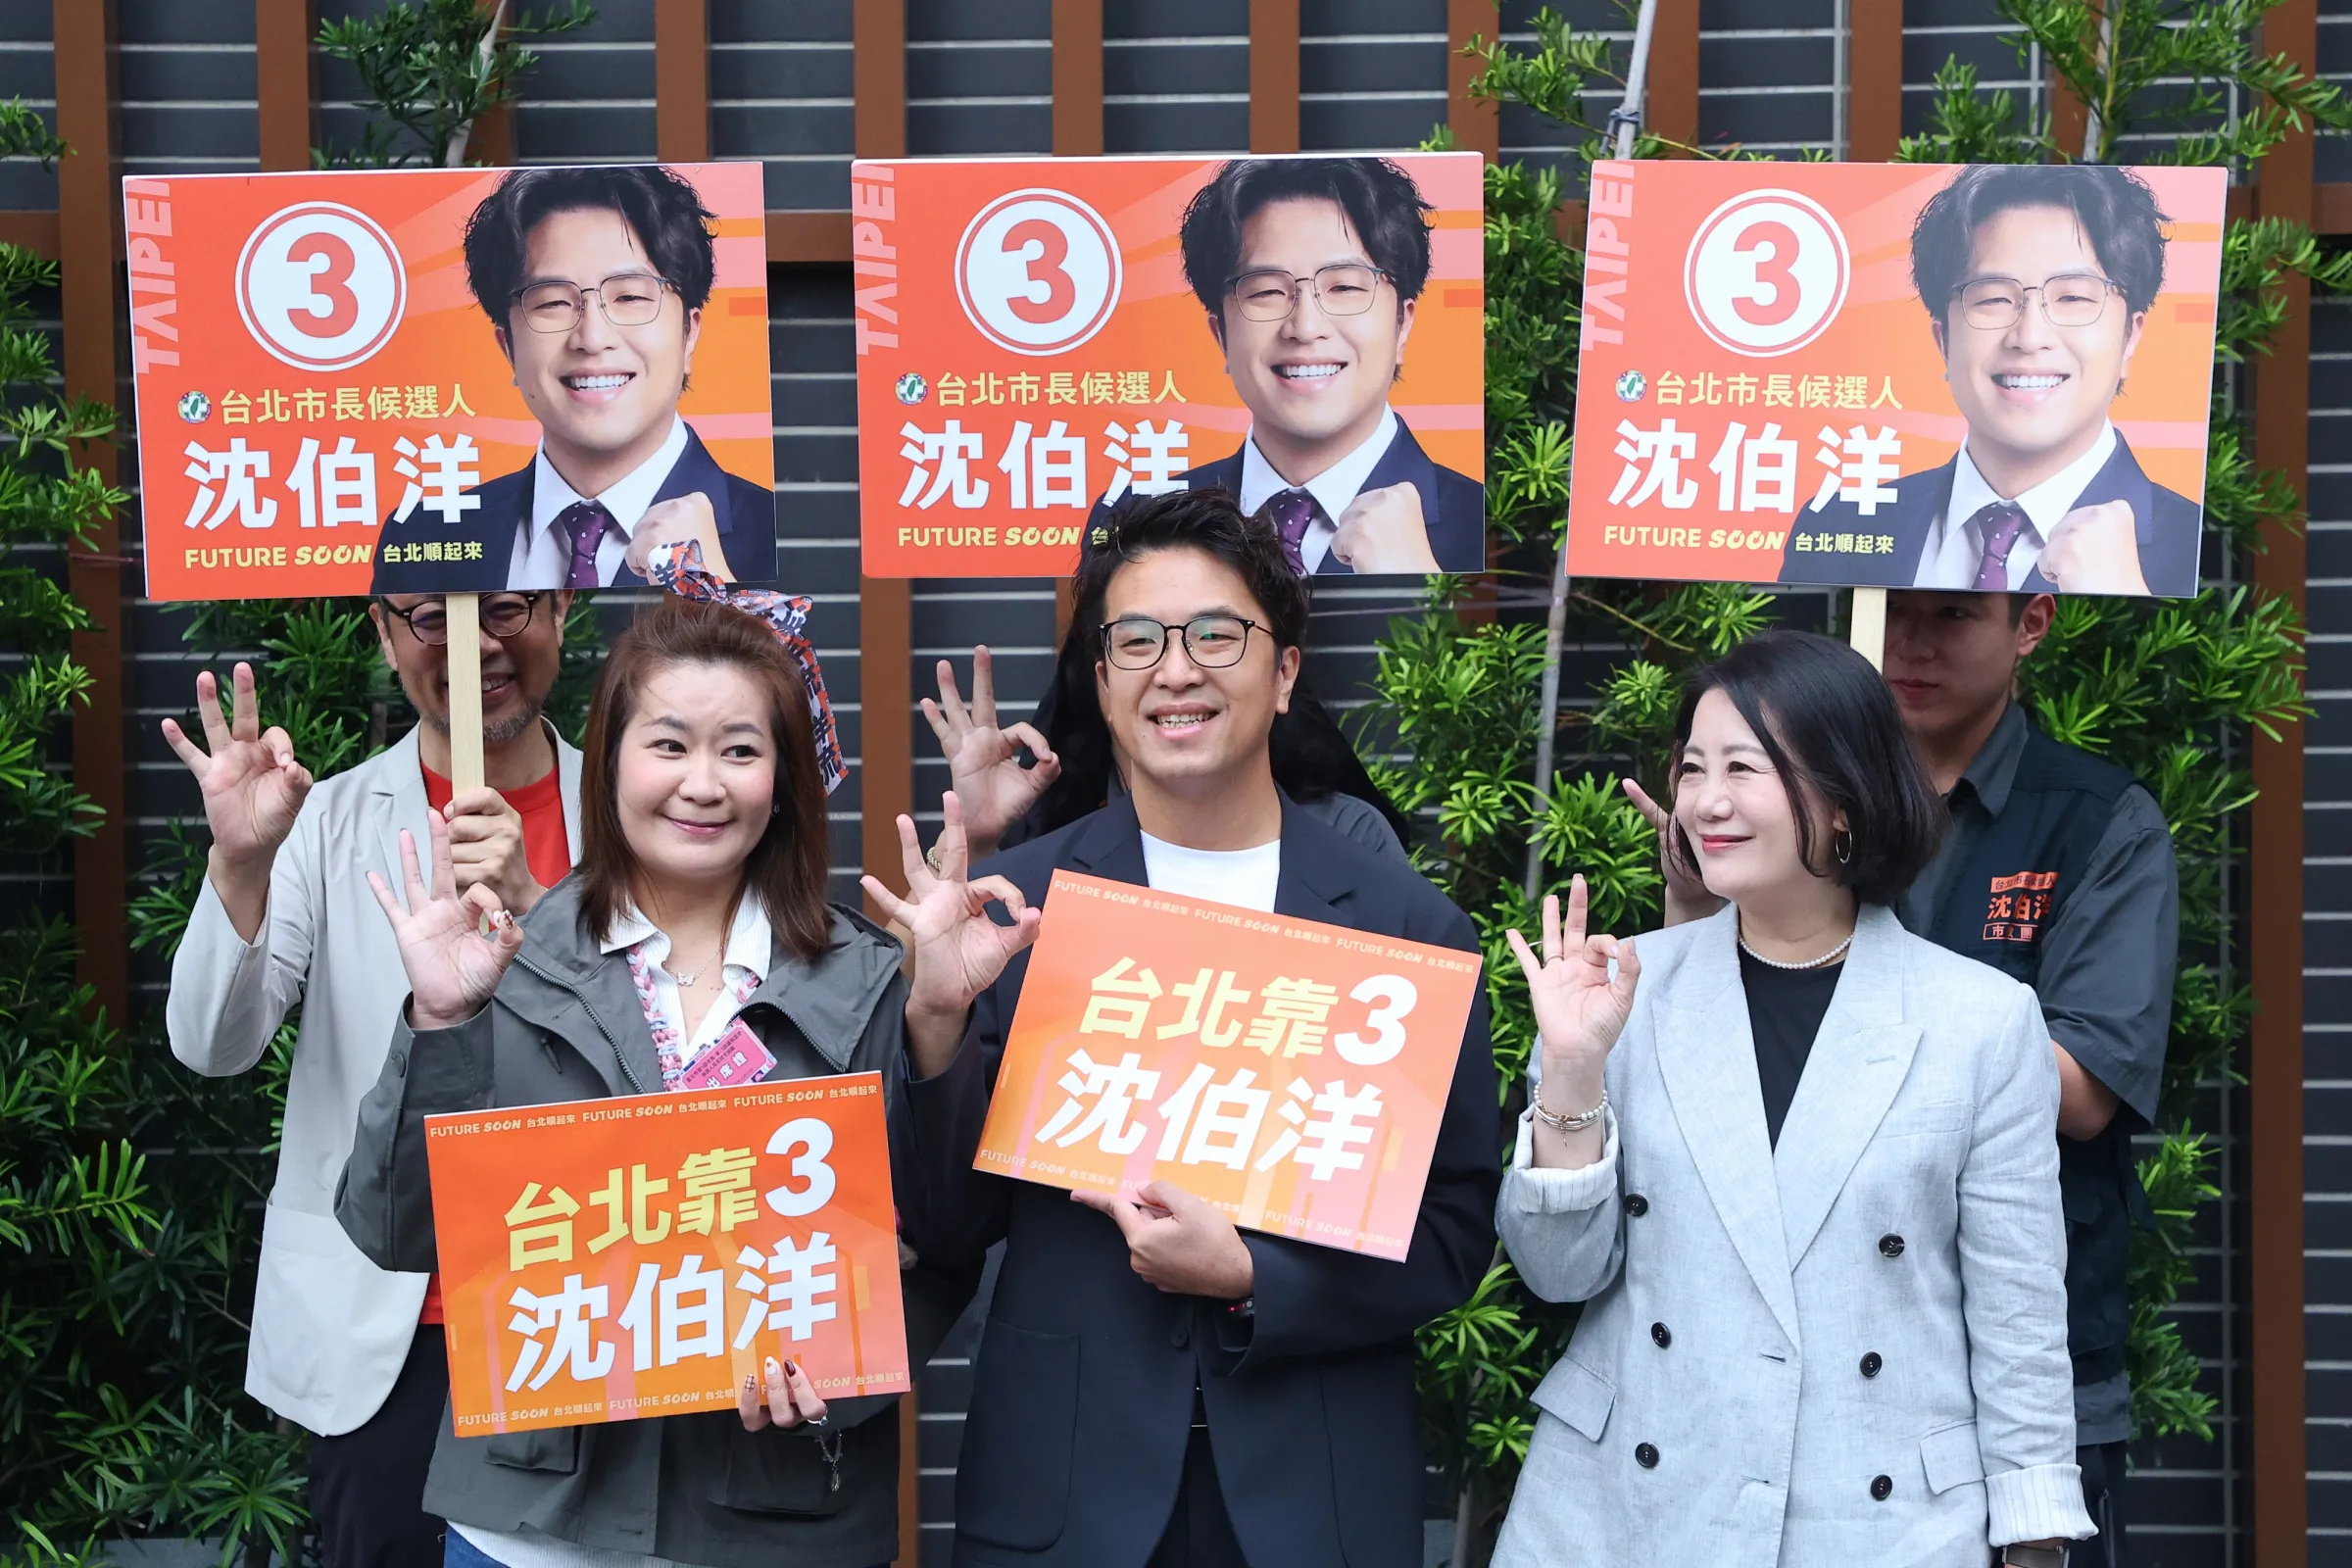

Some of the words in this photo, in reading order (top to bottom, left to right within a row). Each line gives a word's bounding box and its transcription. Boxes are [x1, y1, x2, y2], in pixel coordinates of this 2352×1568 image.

[125, 180, 179, 374] TAIPEI
[285, 232, 358, 339] 3
[853, 165, 899, 356] TAIPEI
[1001, 219, 1076, 324] 3
[1581, 163, 1635, 352] TAIPEI
[1731, 220, 1803, 326] 3
[220, 384, 476, 424] 台北市長候選人
[936, 370, 1188, 407] 台北市長候選人
[1656, 370, 1903, 410] 台北市長候選人
[183, 434, 481, 531] 沈伯洋
[898, 419, 1190, 511] 沈伯洋
[1608, 418, 1901, 515] 沈伯洋
[184, 545, 287, 568] FUTURE
[294, 544, 372, 566] SOON
[382, 541, 483, 564] 台北順起來
[898, 527, 997, 547] FUTURE
[1004, 526, 1081, 546] SOON
[1604, 526, 1701, 548] FUTURE
[1708, 528, 1786, 551] SOON
[1794, 533, 1894, 555] 台北順起來
[1054, 880, 1100, 898] FUTURE
[1102, 891, 1139, 905] SOON
[1195, 908, 1242, 926] FUTURE
[1244, 919, 1280, 934] SOON
[1336, 938, 1385, 956] FUTURE
[1386, 948, 1423, 963] SOON
[430, 1123, 480, 1138] FUTURE
[483, 1119, 522, 1132] SOON
[526, 1114, 576, 1129] 台北順起來
[582, 1108, 632, 1122] FUTURE
[635, 1104, 673, 1117] SOON
[678, 1100, 727, 1113] 台北順起來
[734, 1093, 783, 1107] FUTURE
[786, 1090, 824, 1102] SOON
[828, 1085, 878, 1099] 台北順起來
[1034, 1049, 1384, 1182] 沈伯洋
[980, 1149, 1027, 1167] FUTURE
[1029, 1159, 1065, 1176] SOON
[1264, 1211, 1312, 1229] FUTURE
[1315, 1224, 1352, 1238] SOON
[505, 1231, 837, 1393] 沈伯洋
[458, 1412, 507, 1426] FUTURE
[511, 1407, 549, 1420] SOON
[610, 1396, 660, 1410] FUTURE
[662, 1392, 700, 1405] SOON
[705, 1389, 735, 1402] 台北順
[813, 1377, 851, 1389] SOON
